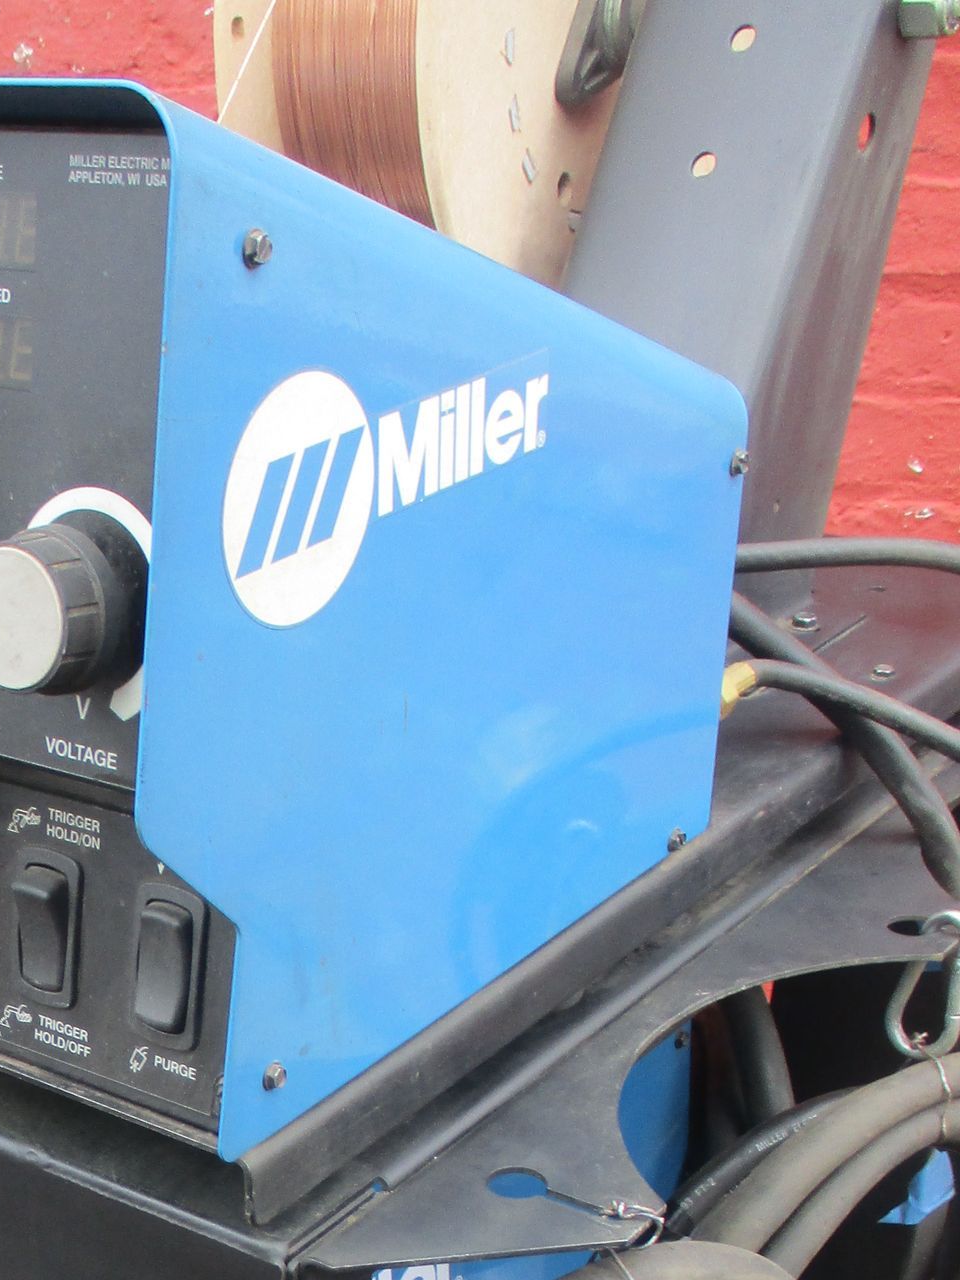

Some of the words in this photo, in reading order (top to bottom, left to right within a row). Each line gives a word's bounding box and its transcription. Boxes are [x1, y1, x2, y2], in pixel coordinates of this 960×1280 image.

[69, 154, 106, 168] MILLER
[107, 155, 159, 170] ELECTRIC
[145, 174, 168, 187] USA
[377, 373, 549, 518] Miller
[45, 736, 118, 771] VOLTAGE
[47, 807, 100, 834] TRIGGER
[46, 823, 101, 850] HOLD/ON
[38, 1013, 89, 1042] TRIGGER
[34, 1027, 92, 1058] HOLD/OFF
[153, 1055, 197, 1081] PURGE
